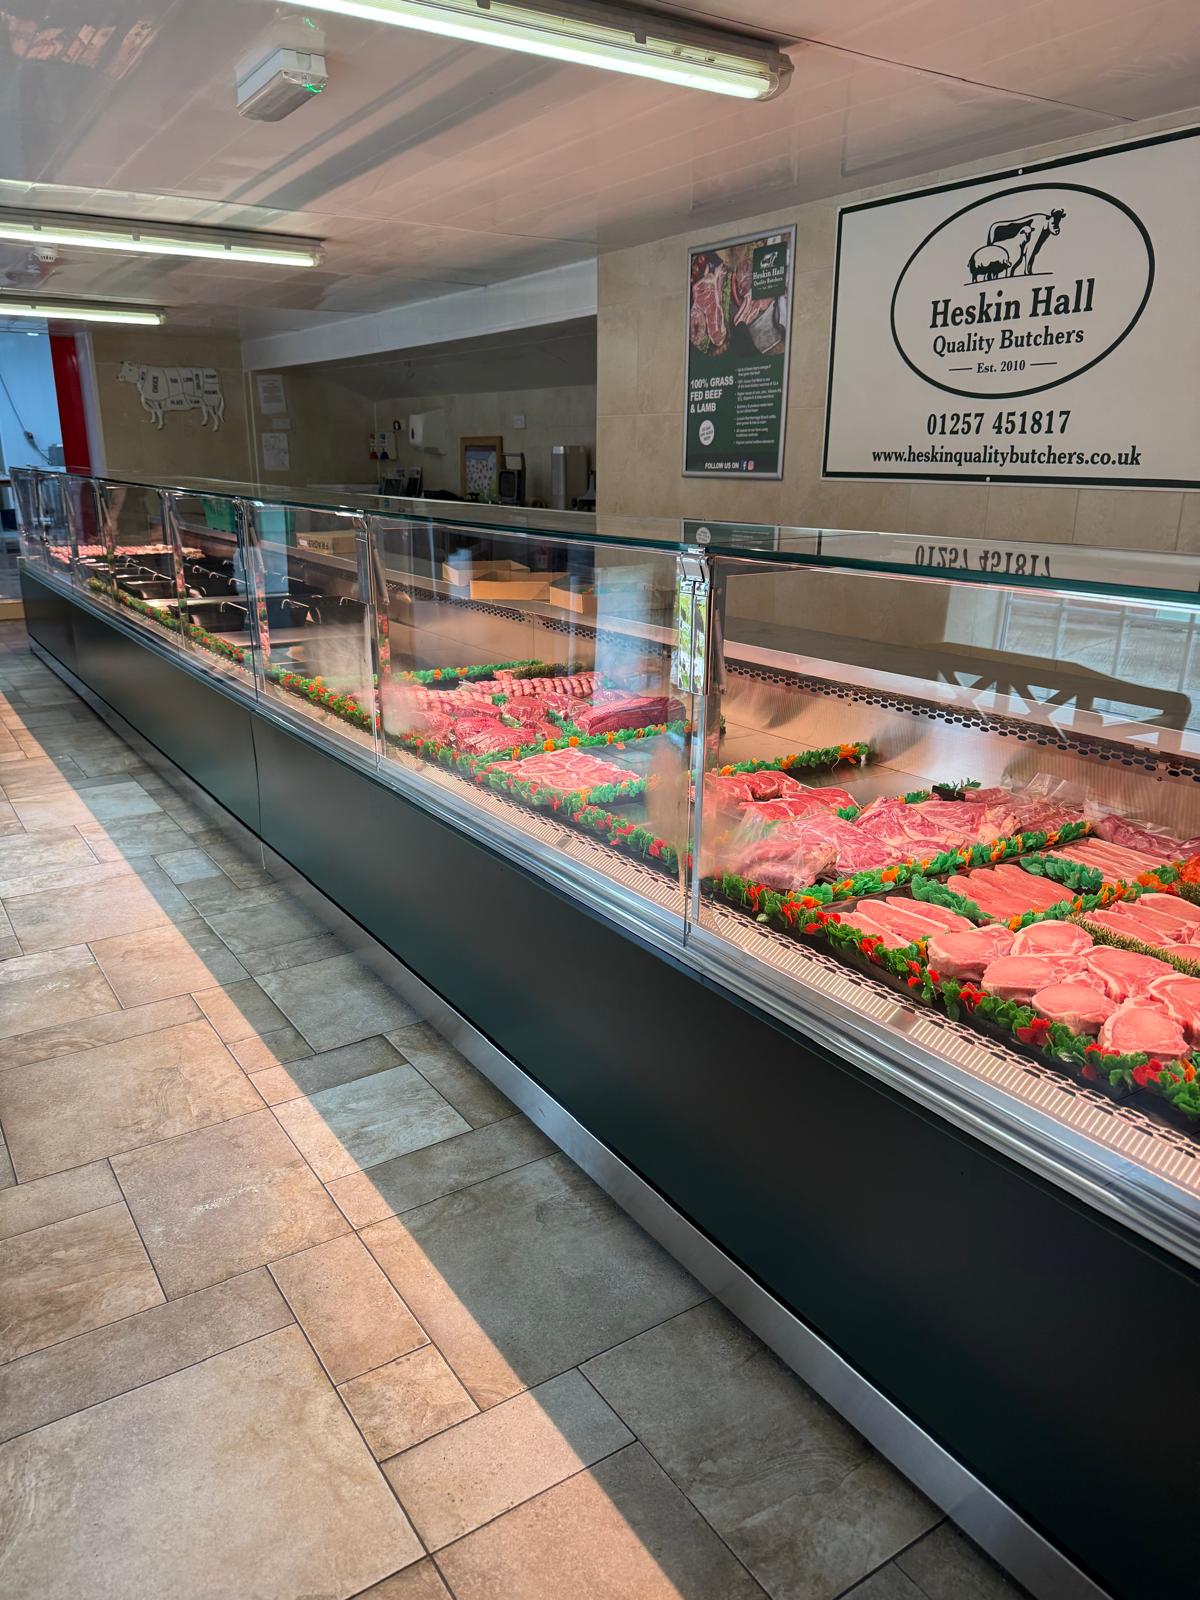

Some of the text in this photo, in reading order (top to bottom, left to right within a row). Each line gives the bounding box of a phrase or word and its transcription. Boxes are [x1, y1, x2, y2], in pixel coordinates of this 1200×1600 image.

[753, 266, 784, 280] Heskin Hall
[929, 278, 1096, 328] Heskin Hall
[933, 326, 1085, 358] Quality Butchers
[976, 360, 1026, 374] Est. 2010
[691, 375, 734, 389] 100% GRASS
[690, 389, 723, 402] FED BEEF
[690, 403, 717, 413] & LAMB
[926, 410, 1071, 435] 01257 451817
[872, 445, 1142, 468] www.heskinqualitybutchers.co.uk
[704, 462, 724, 470] FOLLOW
